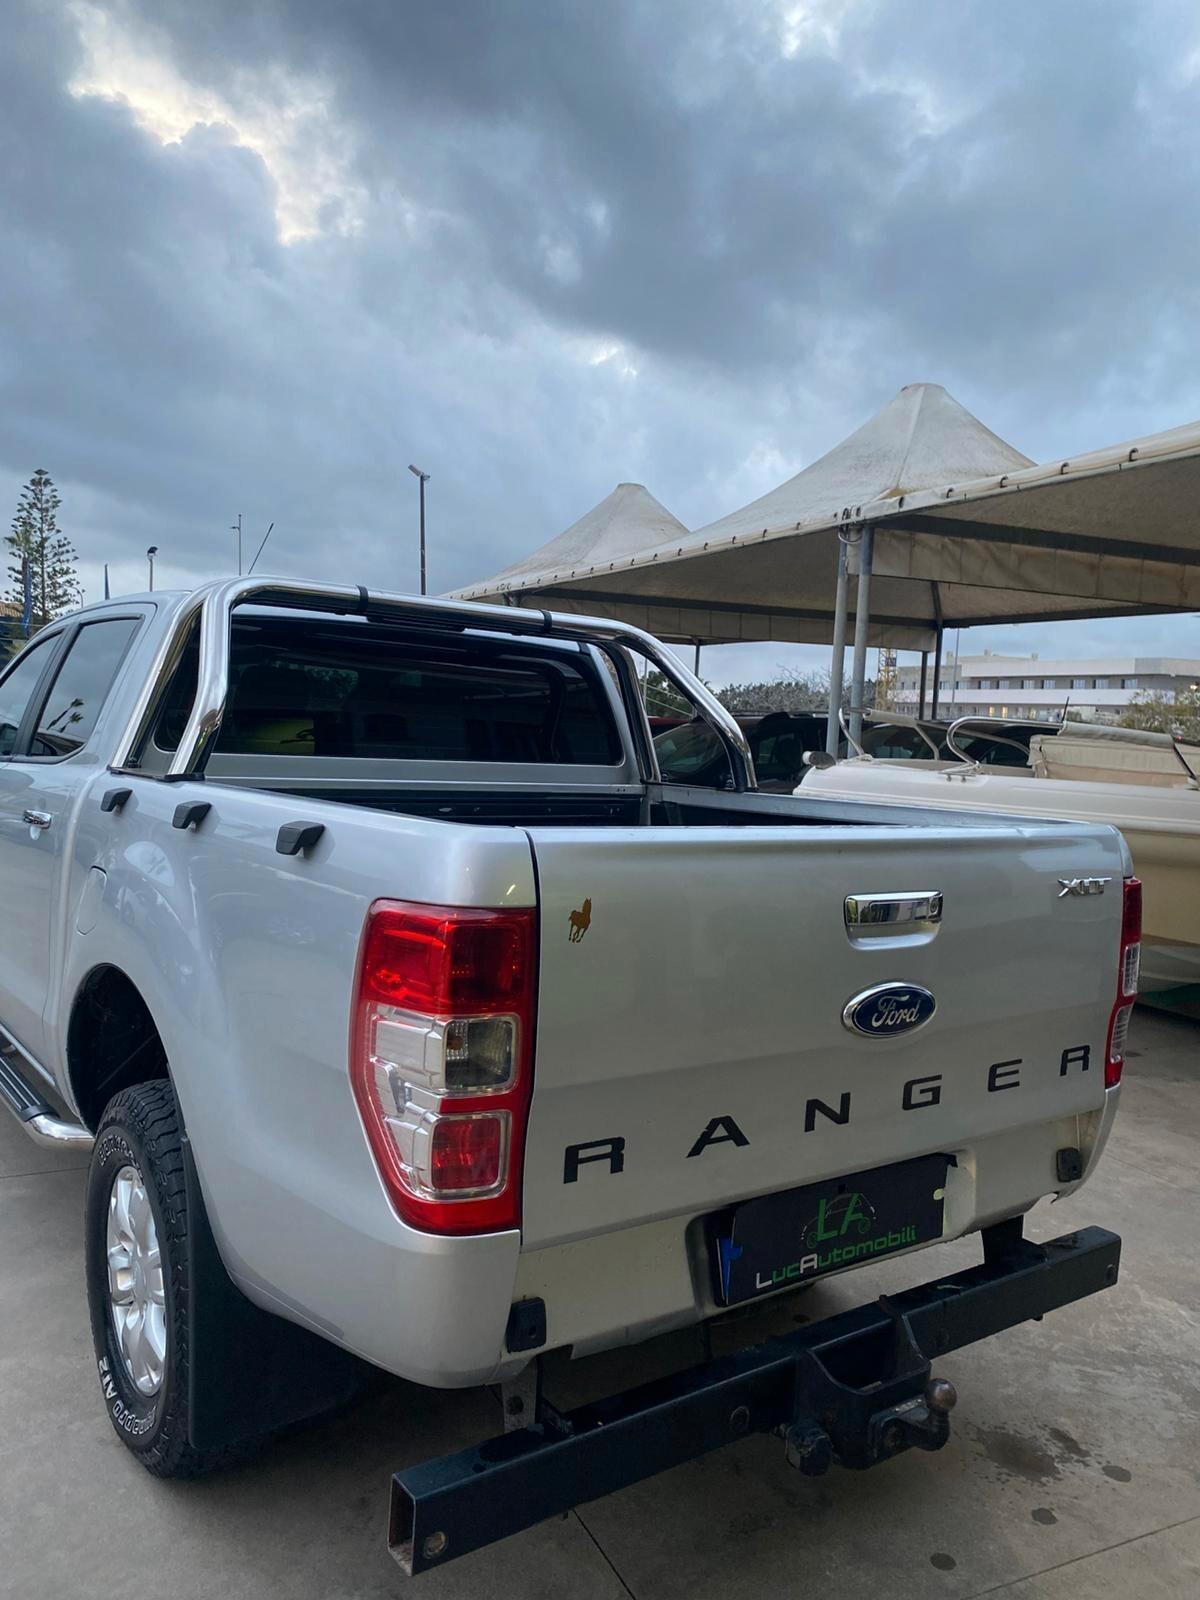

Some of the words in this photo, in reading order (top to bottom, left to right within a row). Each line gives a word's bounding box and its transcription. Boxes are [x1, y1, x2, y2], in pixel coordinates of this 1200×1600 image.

[1057, 877, 1112, 897] XLT
[871, 994, 921, 1028] Ford
[563, 1044, 1091, 1185] RANGER
[755, 1224, 917, 1290] LucAutomobili
